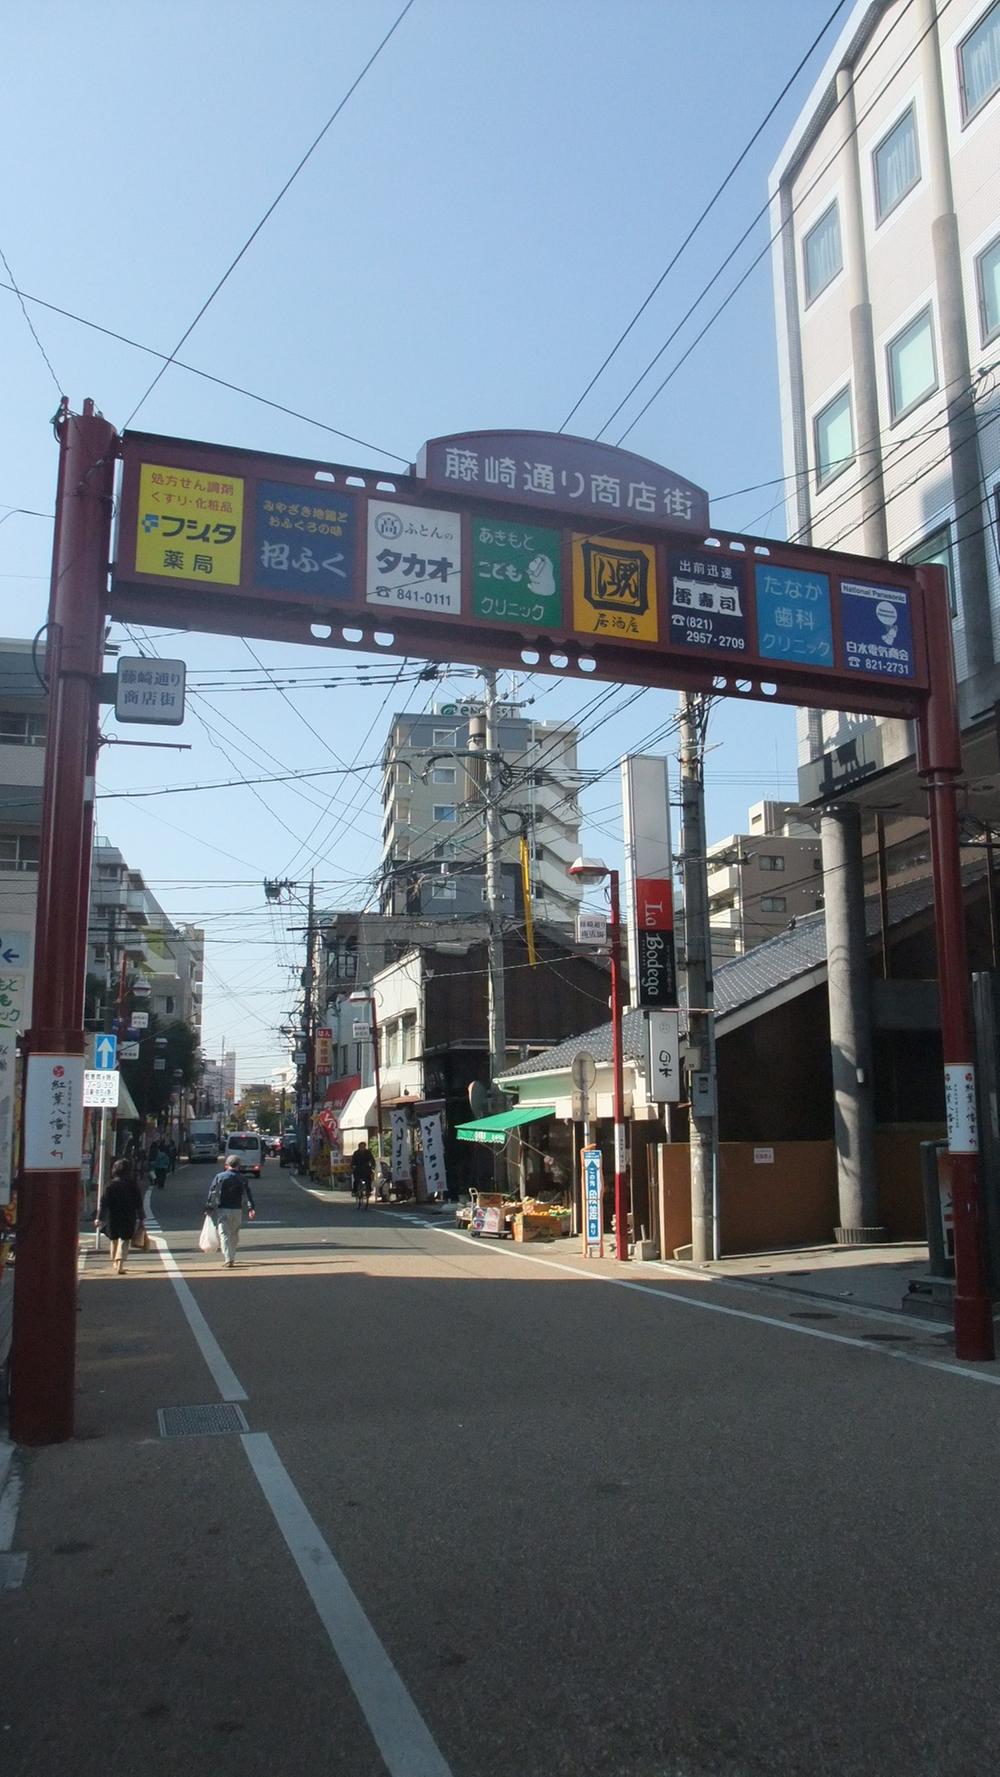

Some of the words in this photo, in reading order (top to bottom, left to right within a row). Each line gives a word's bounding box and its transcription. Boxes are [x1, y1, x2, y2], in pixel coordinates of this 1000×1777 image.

[152, 472, 234, 496] 処方せん調剤
[445, 448, 692, 520] 藤崎通り商店街
[161, 515, 236, 544] フジタ
[405, 523, 453, 540] ふとんの
[480, 527, 535, 551] あきもと
[163, 550, 213, 574] 薬局
[260, 540, 347, 578] 招ふく
[376, 548, 453, 583] タカオ
[680, 560, 732, 579] 出前迅速
[479, 561, 522, 582] こども
[397, 588, 451, 606] 841-0111
[764, 576, 822, 600] たなか
[481, 597, 544, 620] クリニック
[775, 606, 814, 631] 歯科
[686, 616, 713, 631] (821)
[763, 633, 830, 657] クリニック
[121, 670, 179, 686] 藤崎通り
[865, 659, 909, 675] 821-2731
[124, 690, 176, 706] 商店街
[645, 900, 663, 926] La
[641, 932, 665, 995] Bodega
